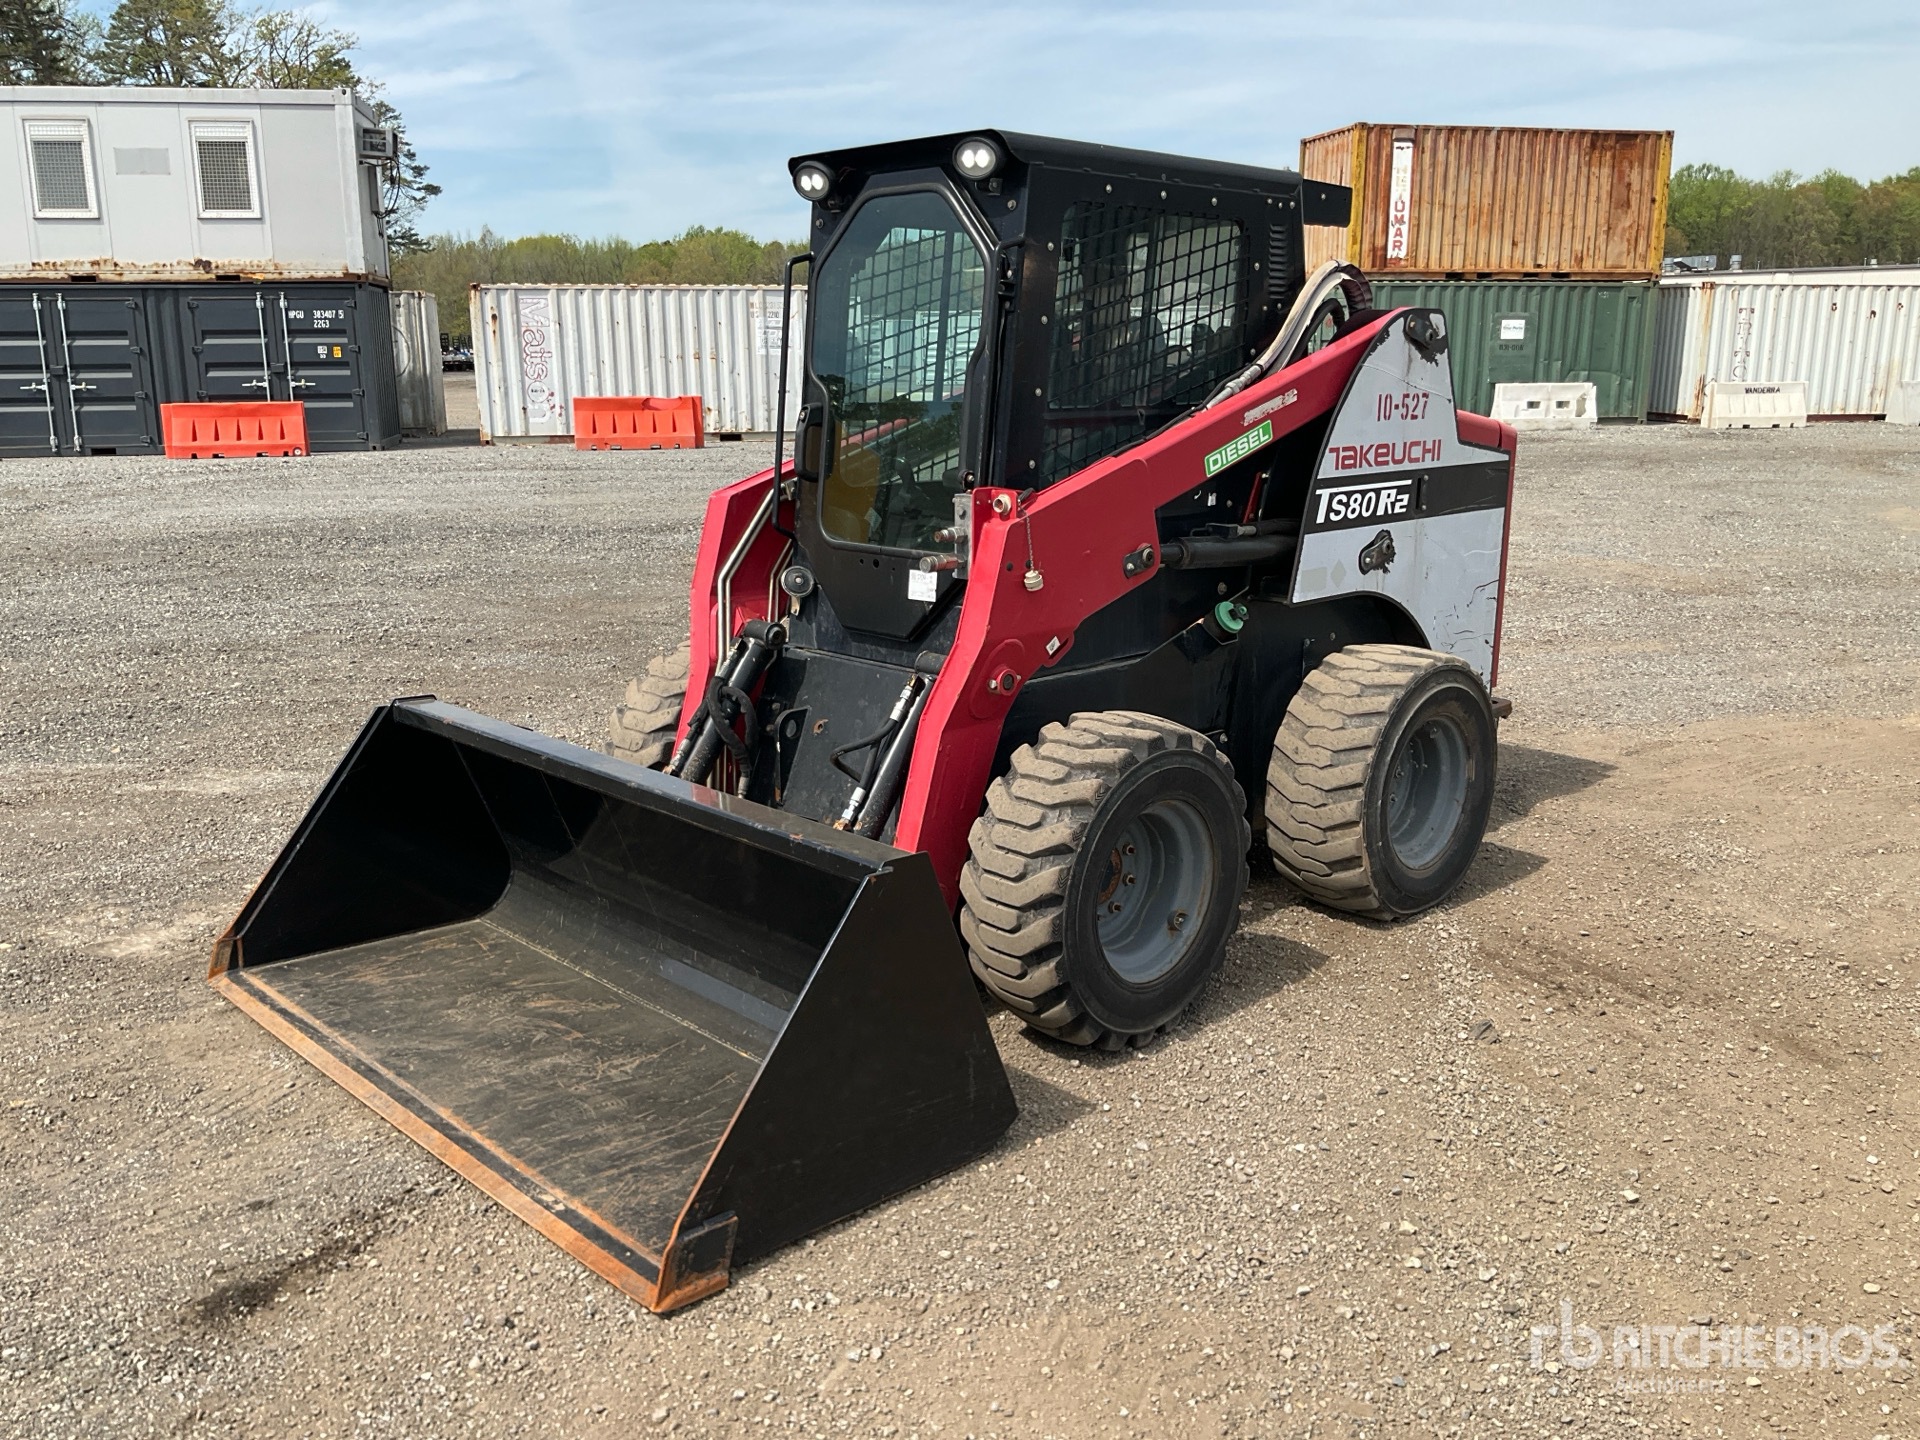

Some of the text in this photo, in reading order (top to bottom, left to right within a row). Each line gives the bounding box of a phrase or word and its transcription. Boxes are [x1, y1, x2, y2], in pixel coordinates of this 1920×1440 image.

[288, 310, 344, 319] HPGU 383407 5
[313, 320, 330, 328] 22G3
[519, 297, 553, 423] Matson
[1732, 307, 1755, 382] TRITO
[1376, 392, 1430, 422] 10-527
[1208, 426, 1270, 473] DIESEL
[1328, 439, 1442, 471] TAKEUCHI
